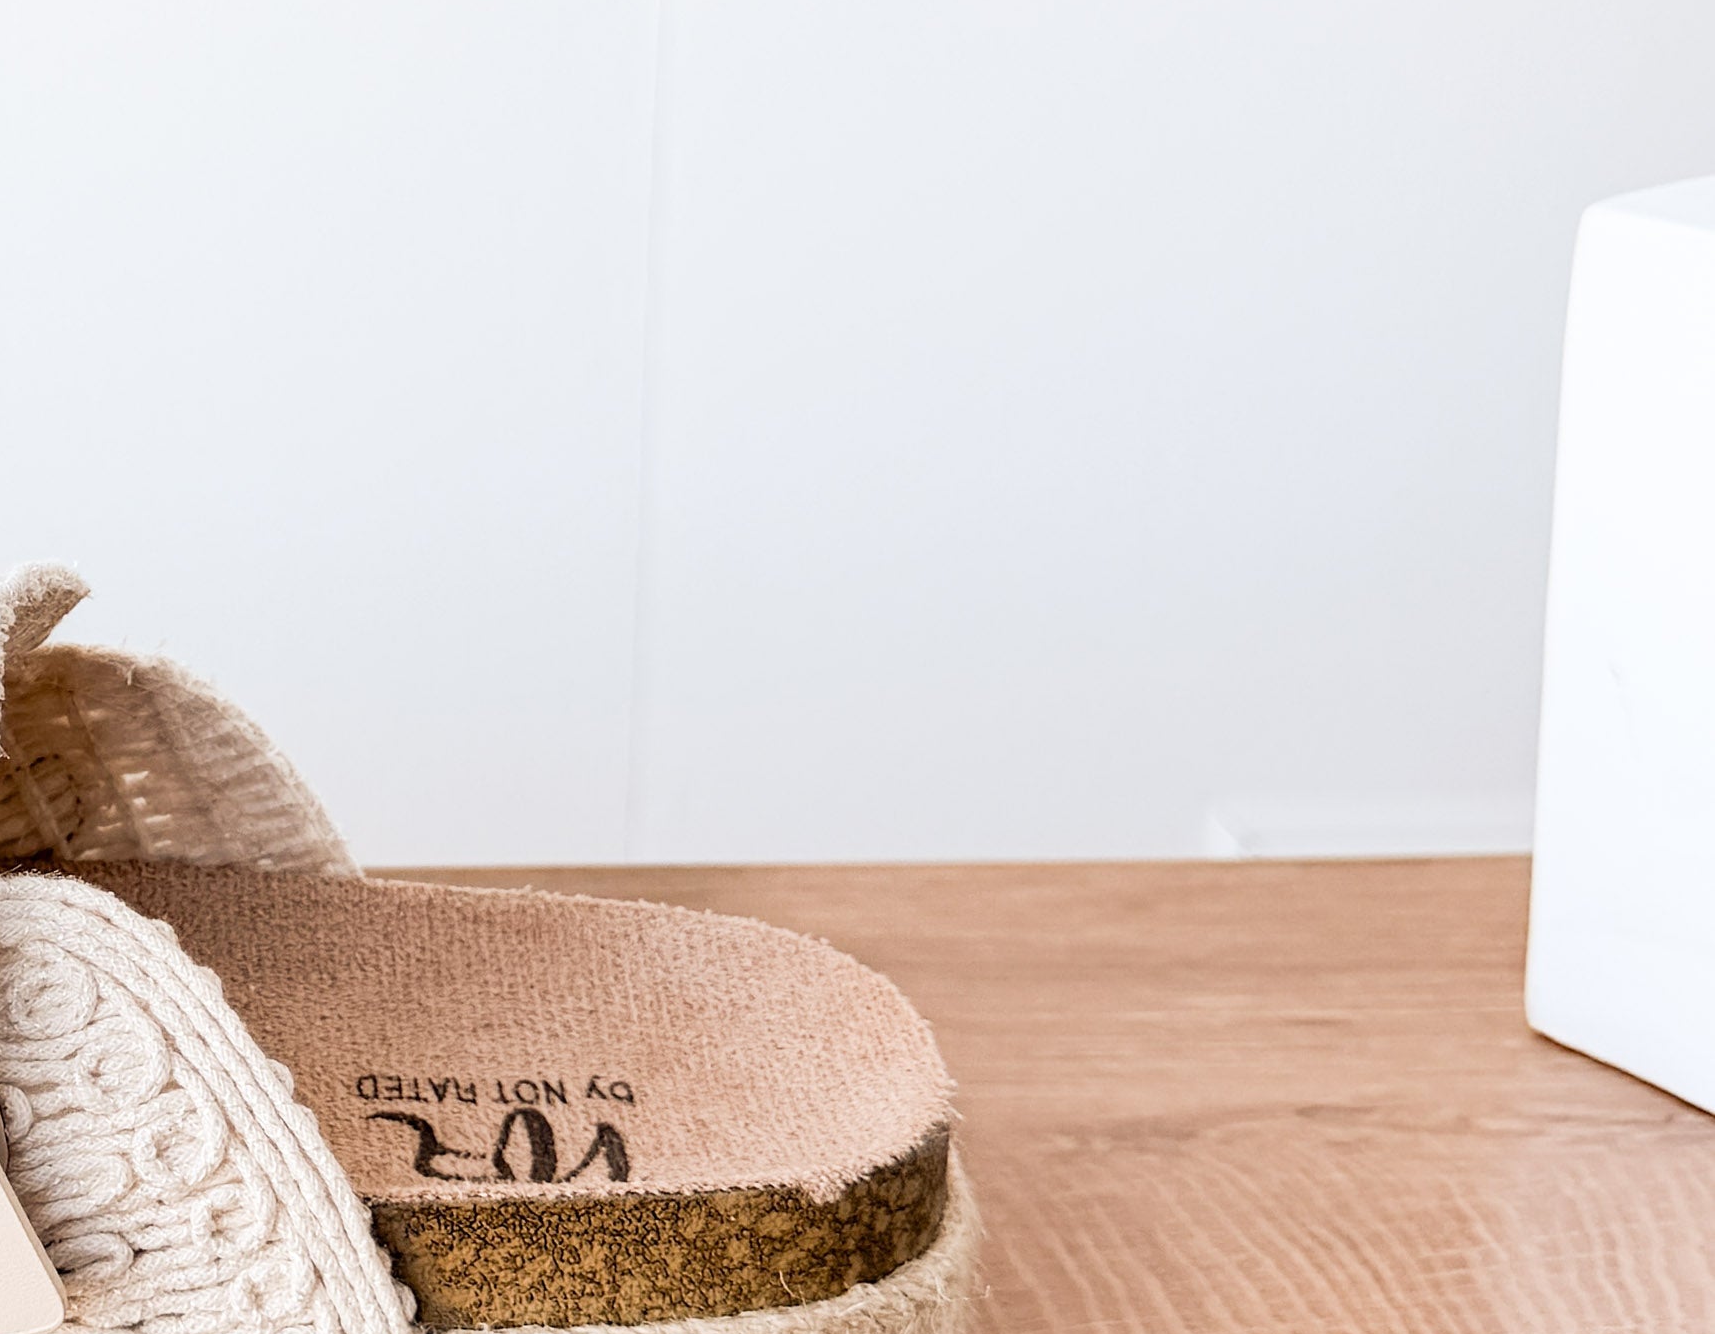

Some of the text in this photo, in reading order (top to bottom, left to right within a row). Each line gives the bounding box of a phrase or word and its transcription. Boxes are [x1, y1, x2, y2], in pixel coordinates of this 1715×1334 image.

[356, 1073, 635, 1106] by NOT RATED
